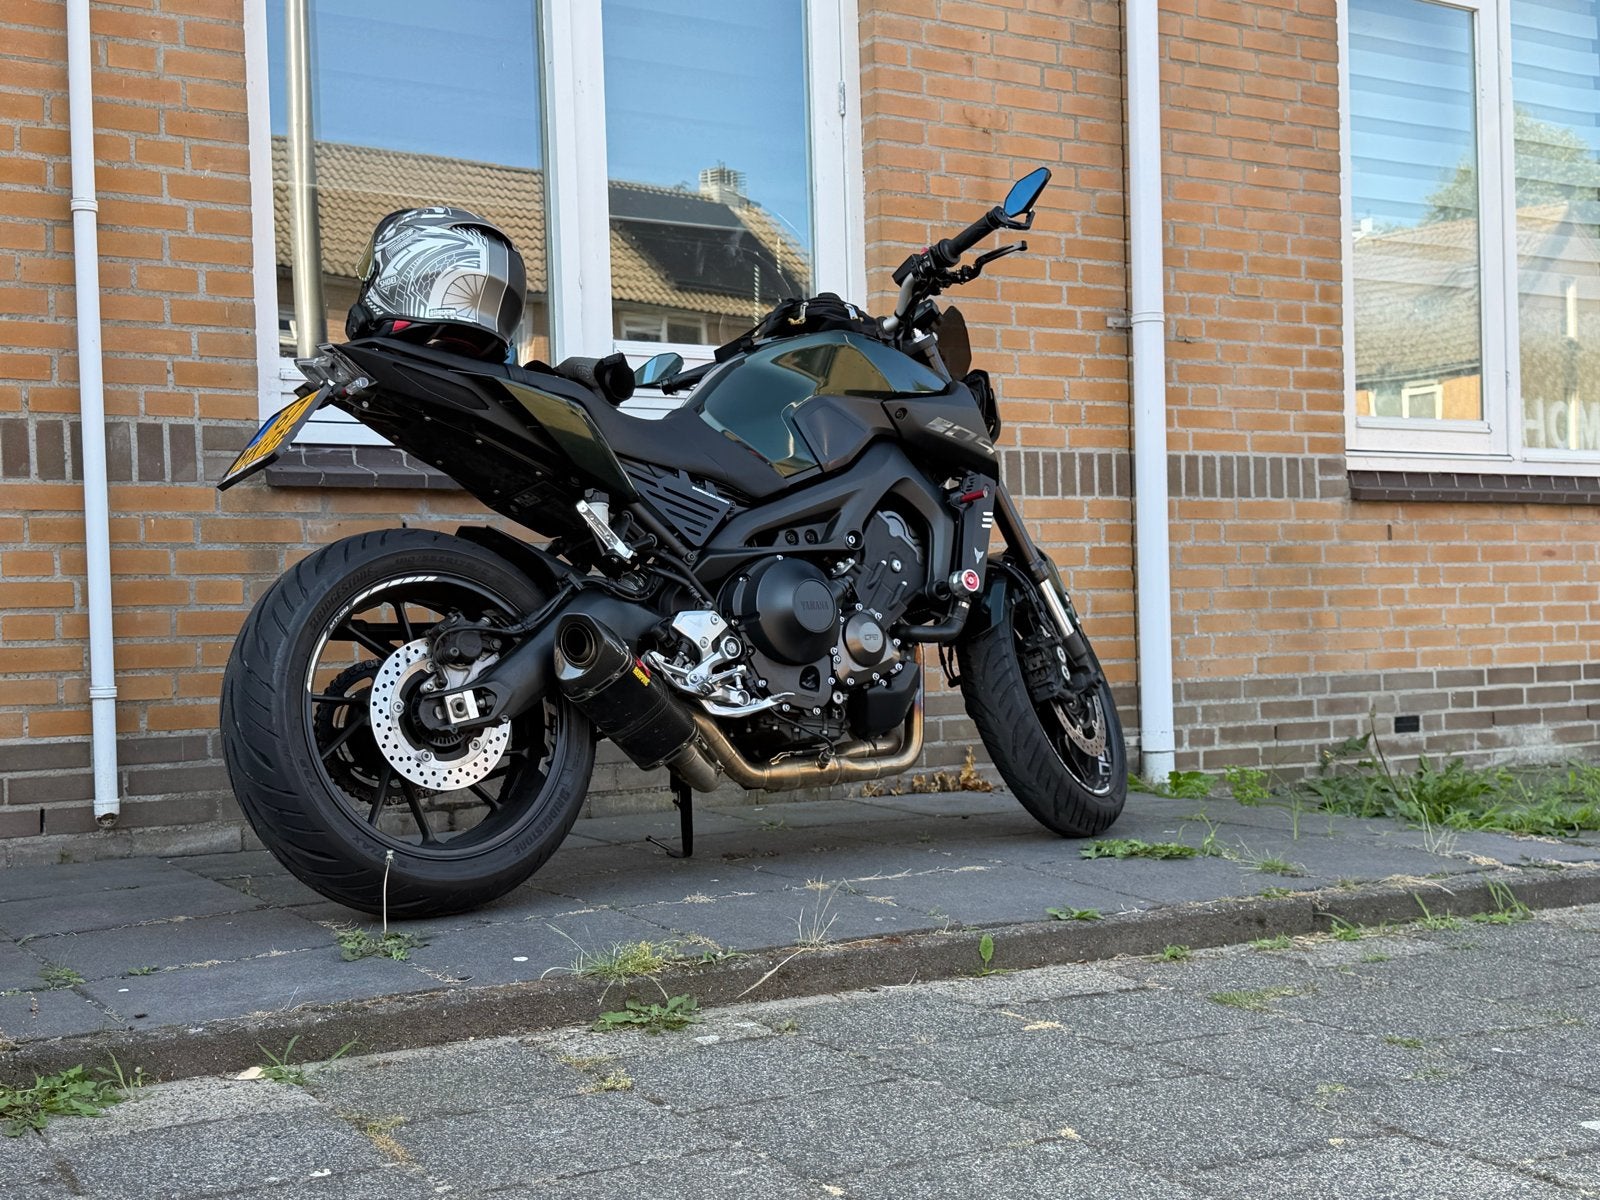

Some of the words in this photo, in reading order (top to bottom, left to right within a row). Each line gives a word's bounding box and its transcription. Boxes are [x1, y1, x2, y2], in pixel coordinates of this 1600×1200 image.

[379, 275, 398, 289] SHOEI
[274, 396, 312, 431] 67
[308, 565, 376, 631] BRIDGESTONE
[800, 600, 830, 611] YAMAHA
[513, 787, 571, 856] BRIDGESTONE
